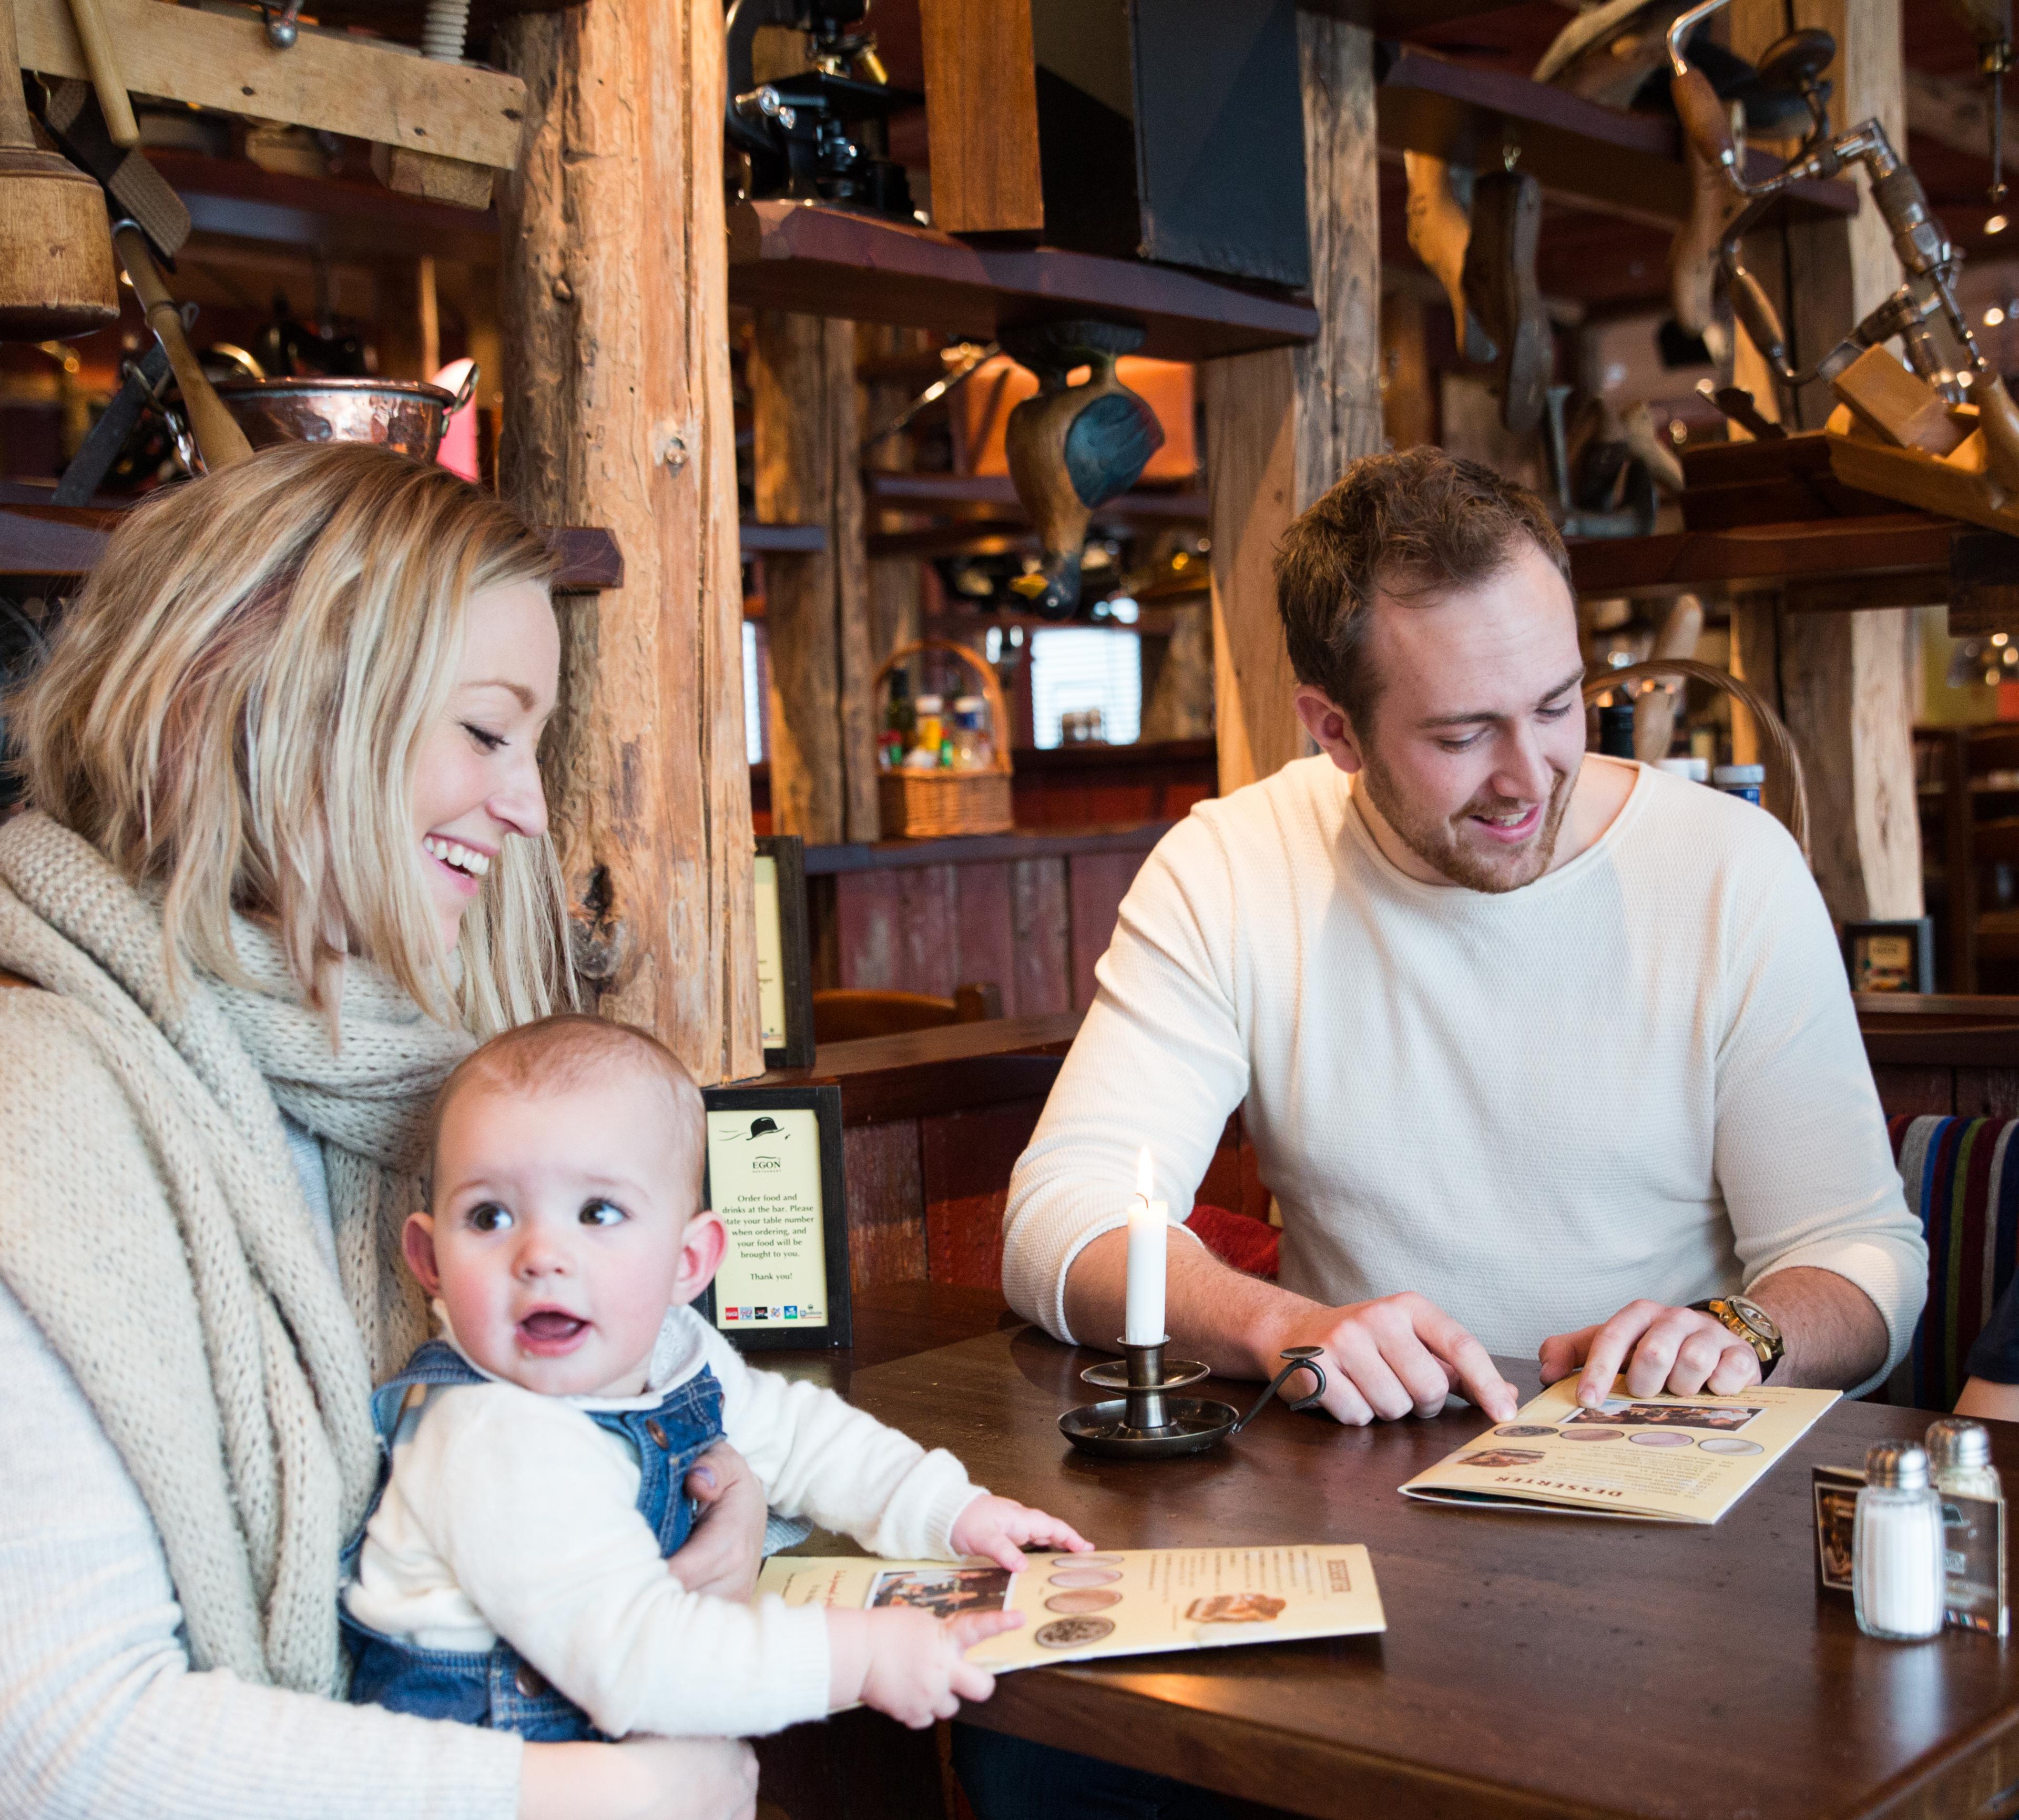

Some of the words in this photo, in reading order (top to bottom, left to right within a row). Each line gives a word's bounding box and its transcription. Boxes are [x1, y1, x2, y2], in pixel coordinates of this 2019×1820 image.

[755, 1228, 790, 1236] ordering,
[740, 1251, 771, 1259] brought
[776, 1273, 792, 1282] you!
[1495, 1477, 1623, 1497] DESSERTER
